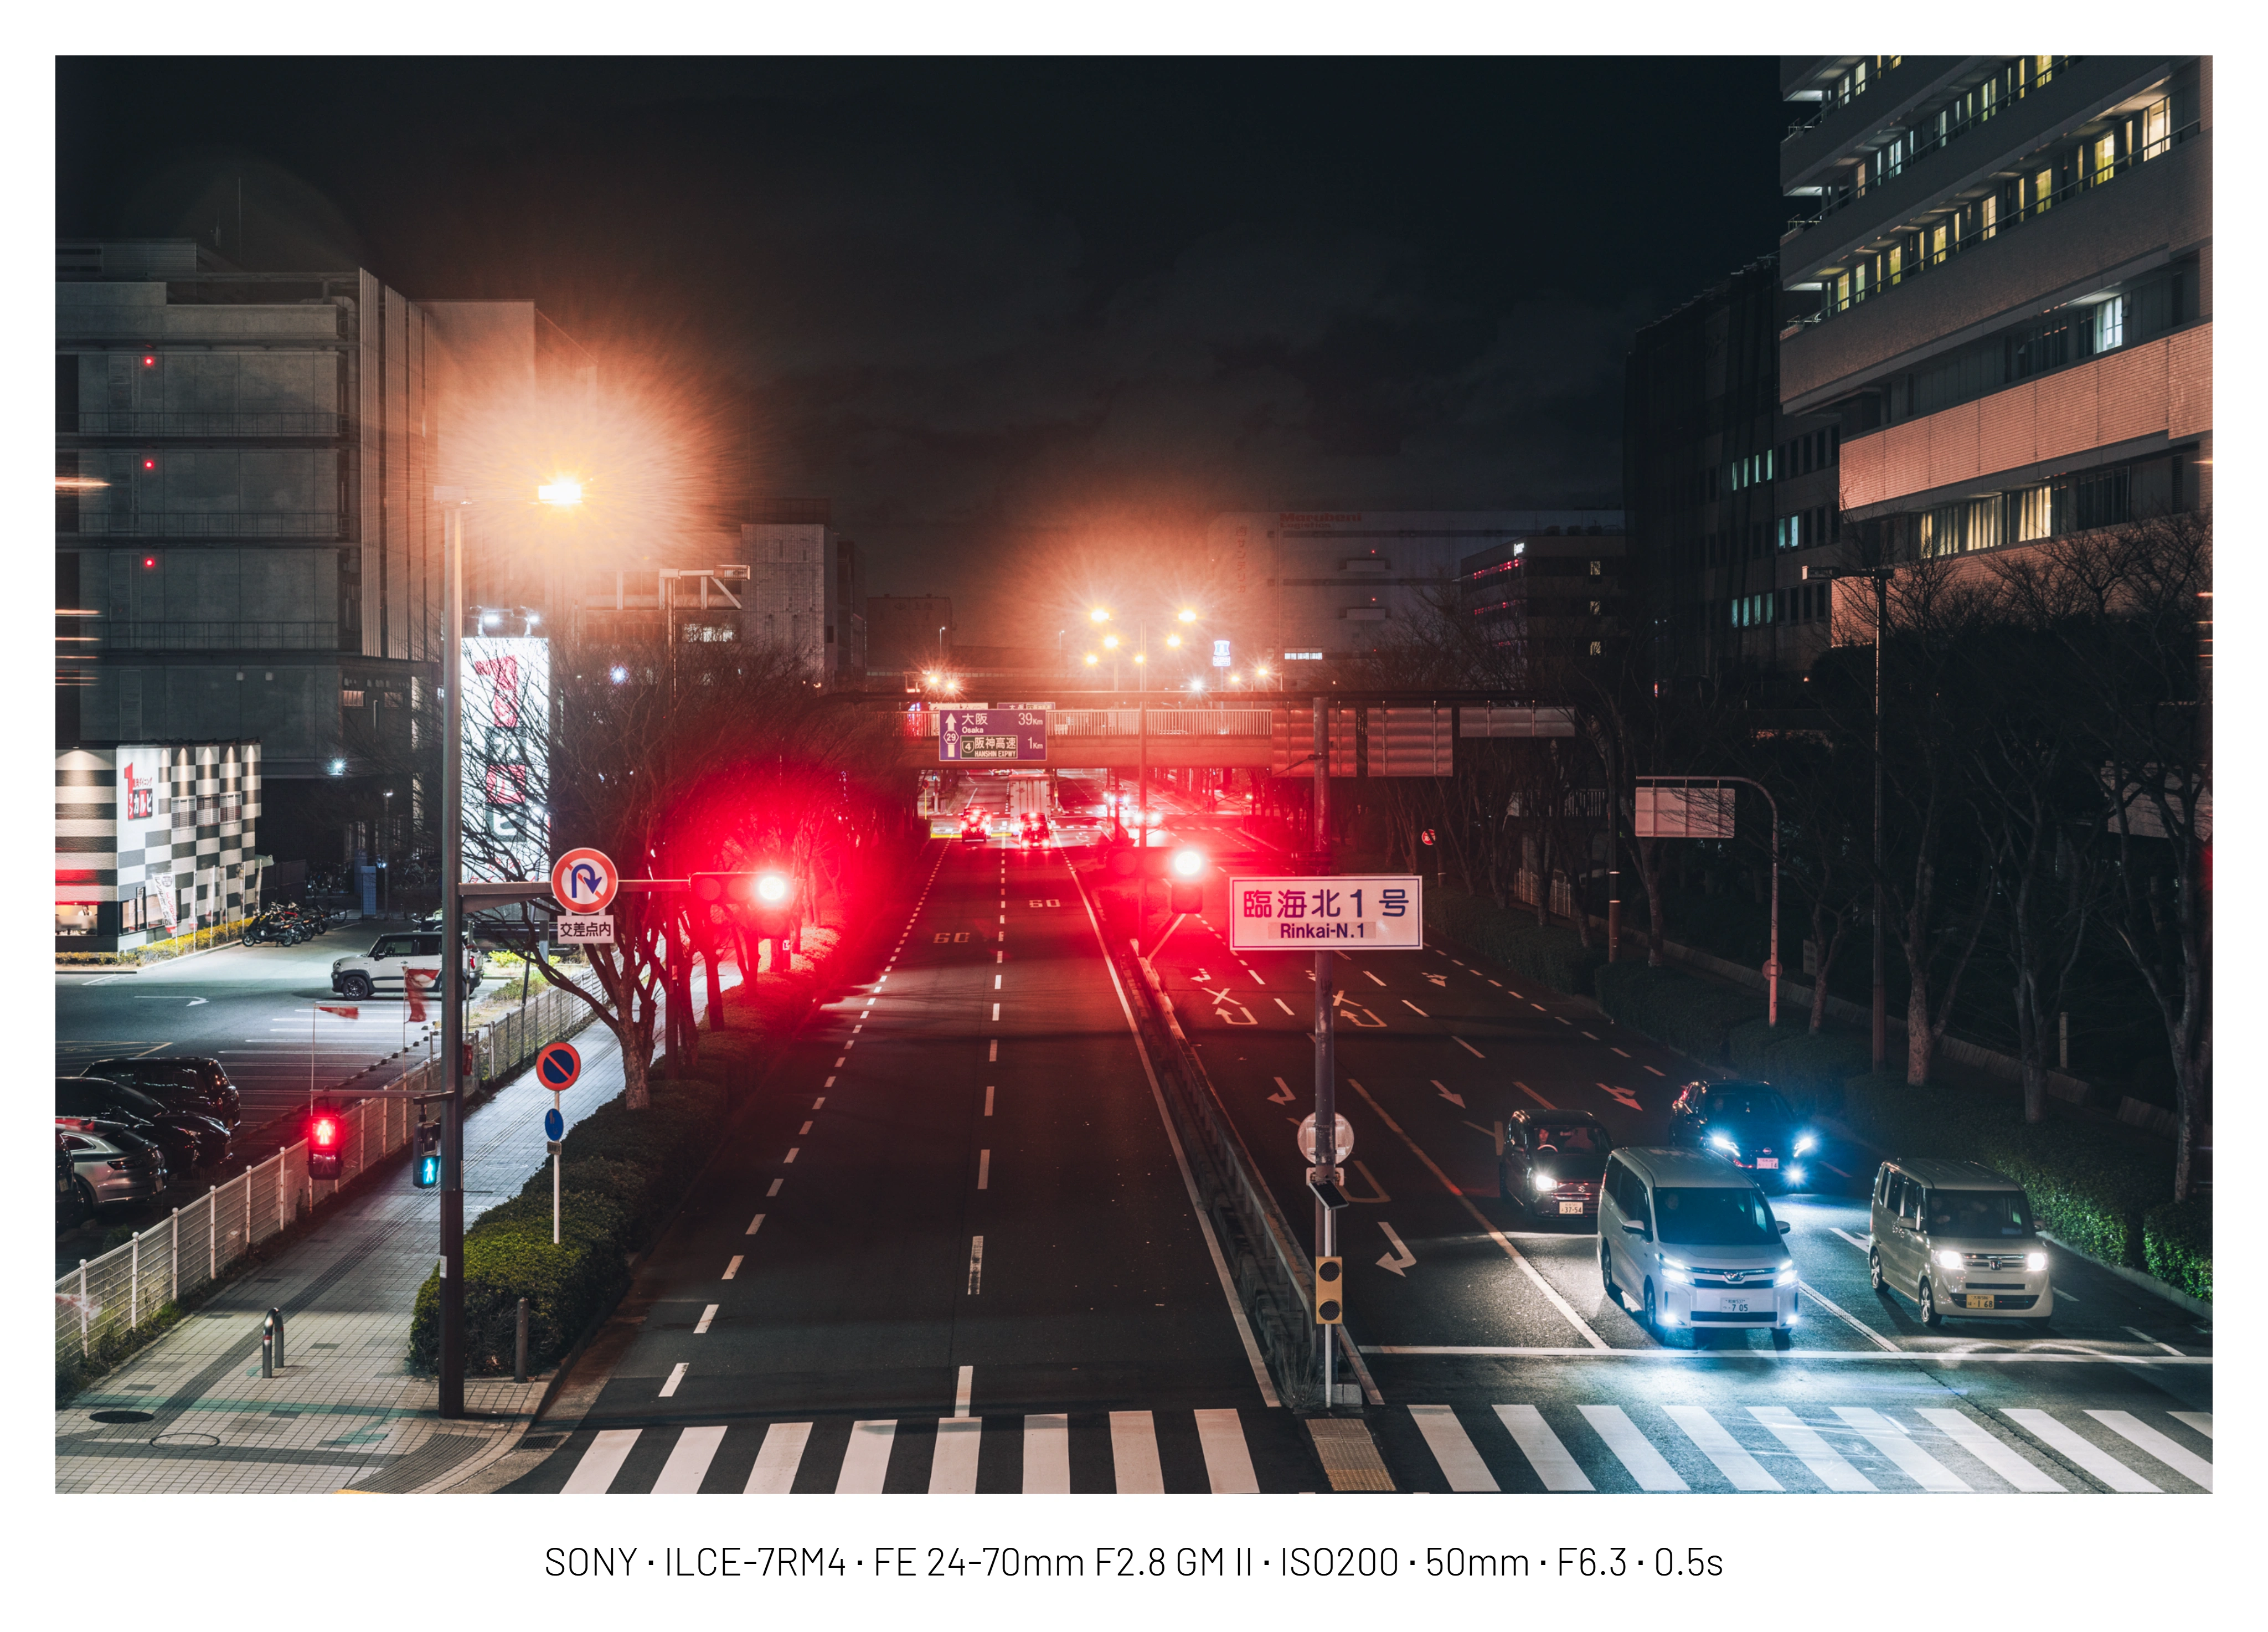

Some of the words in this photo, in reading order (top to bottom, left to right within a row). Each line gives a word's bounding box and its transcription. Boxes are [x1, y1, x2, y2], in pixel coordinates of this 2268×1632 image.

[1280, 513, 1362, 522] Marubeni
[962, 713, 988, 725] 大阪
[975, 737, 1016, 749] 阪神高速
[133, 792, 152, 814] カルビ
[1029, 899, 1061, 908] 60
[1244, 889, 1409, 918] 臨海北1号
[560, 922, 611, 937] 交差点内
[933, 932, 970, 944] 60
